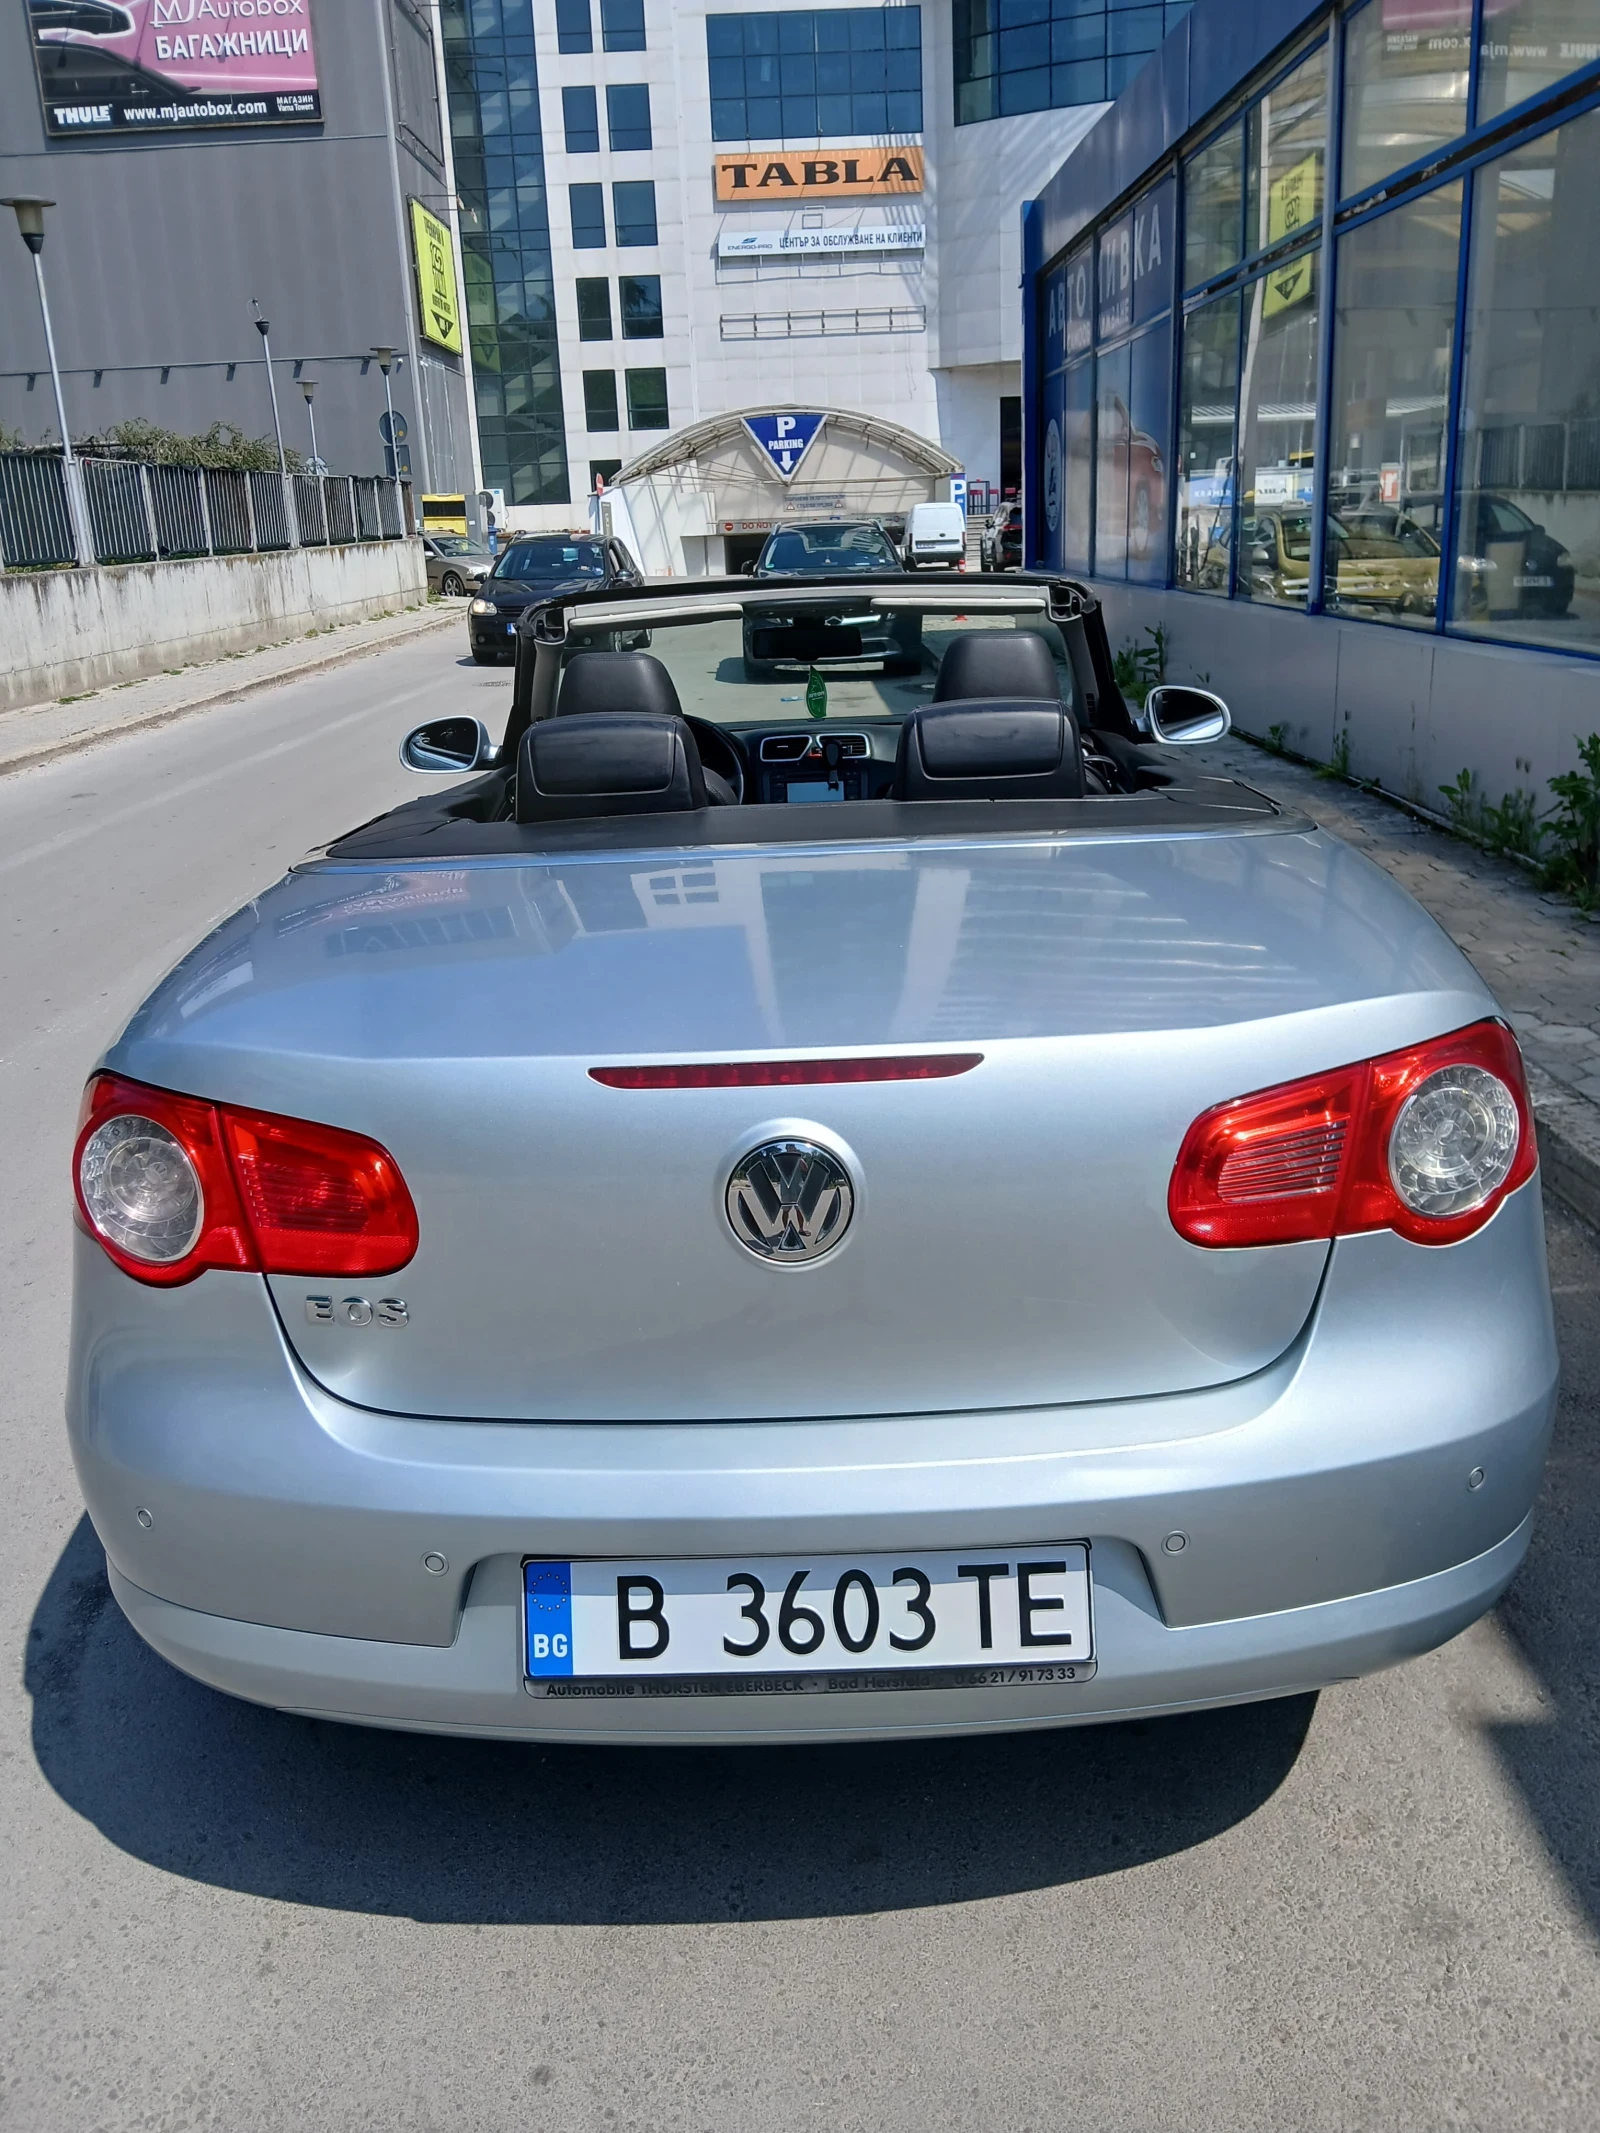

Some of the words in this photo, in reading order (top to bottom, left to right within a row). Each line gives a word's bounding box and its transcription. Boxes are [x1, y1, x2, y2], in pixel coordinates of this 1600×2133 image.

[156, 28, 309, 60] БАГАЖНИЦИ
[276, 95, 313, 104] МАГАЗИН
[54, 105, 112, 124] THULE
[123, 101, 267, 121] www.mjautobox.com
[722, 157, 919, 188] TABLA
[779, 236, 809, 249] ЦЕНТЪР
[810, 235, 820, 247] ЗА
[823, 233, 874, 246] ОБСЛУЖВАНЕ
[875, 233, 885, 244] НА
[887, 231, 923, 244] КЛИЕНТИ
[777, 416, 796, 438] P
[768, 438, 804, 450] PARKING
[741, 522, 754, 530] DO
[305, 1295, 410, 1327] EOS
[617, 1575, 670, 1659] B
[723, 1567, 936, 1656] 3603
[957, 1561, 1072, 1648] TE
[533, 1633, 568, 1658] BG
[546, 1682, 635, 1697] Automobile
[640, 1681, 721, 1695] THORSTEN
[726, 1680, 804, 1693] EBERBECK
[828, 1677, 858, 1690] Bad
[864, 1674, 931, 1689] Hersfeld
